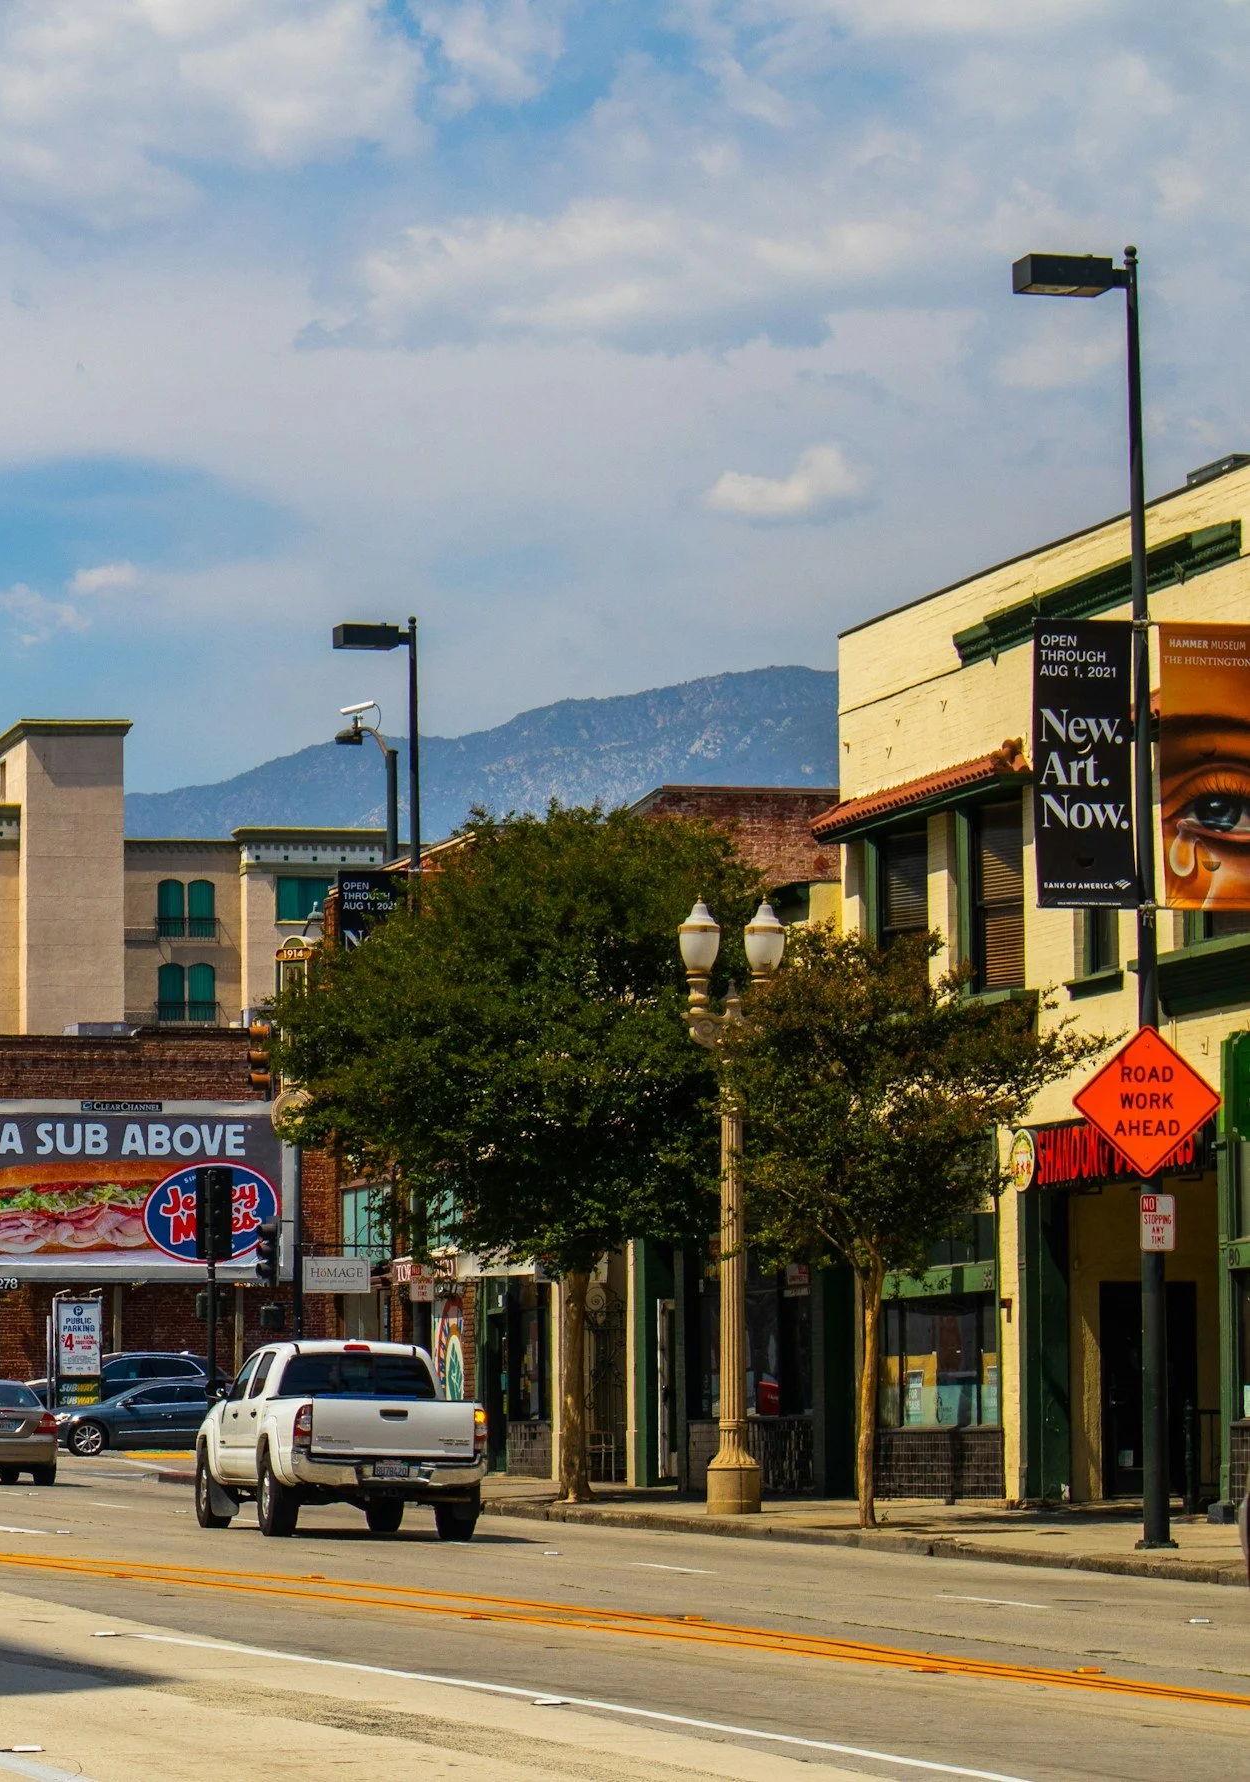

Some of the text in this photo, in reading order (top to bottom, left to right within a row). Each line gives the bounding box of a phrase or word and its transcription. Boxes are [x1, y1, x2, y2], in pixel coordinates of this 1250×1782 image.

[1040, 635, 1077, 647] OPEN
[1169, 638, 1247, 651] HAMMER MUSEUM
[1040, 649, 1107, 663] THROUGH
[1162, 655, 1183, 664] THE
[1039, 665, 1117, 679] AUG 1, 2021
[1039, 707, 1124, 744] New.
[1039, 751, 1110, 787] Art.
[1040, 793, 1130, 830] Now.
[342, 881, 370, 890] OPEN
[1078, 882, 1114, 890] AMERICA
[342, 901, 364, 910] AUG
[282, 950, 304, 959] 1914
[1120, 1066, 1174, 1083] ROAD
[1120, 1092, 1174, 1110] WORK
[1113, 1119, 1180, 1137] AHEAD
[36, 1122, 109, 1155] SUB
[120, 1123, 246, 1156] ABOVE
[1142, 1197, 1155, 1211] NO
[1143, 1214, 1172, 1225] STOPPING
[1151, 1226, 1165, 1235] ANY
[1151, 1235, 1165, 1244] TIME
[65, 1317, 92, 1325] PUBLIC
[63, 1324, 96, 1332] PARKING
[59, 1382, 99, 1393] SUBWAY
[60, 1396, 99, 1405] SUBWAY
